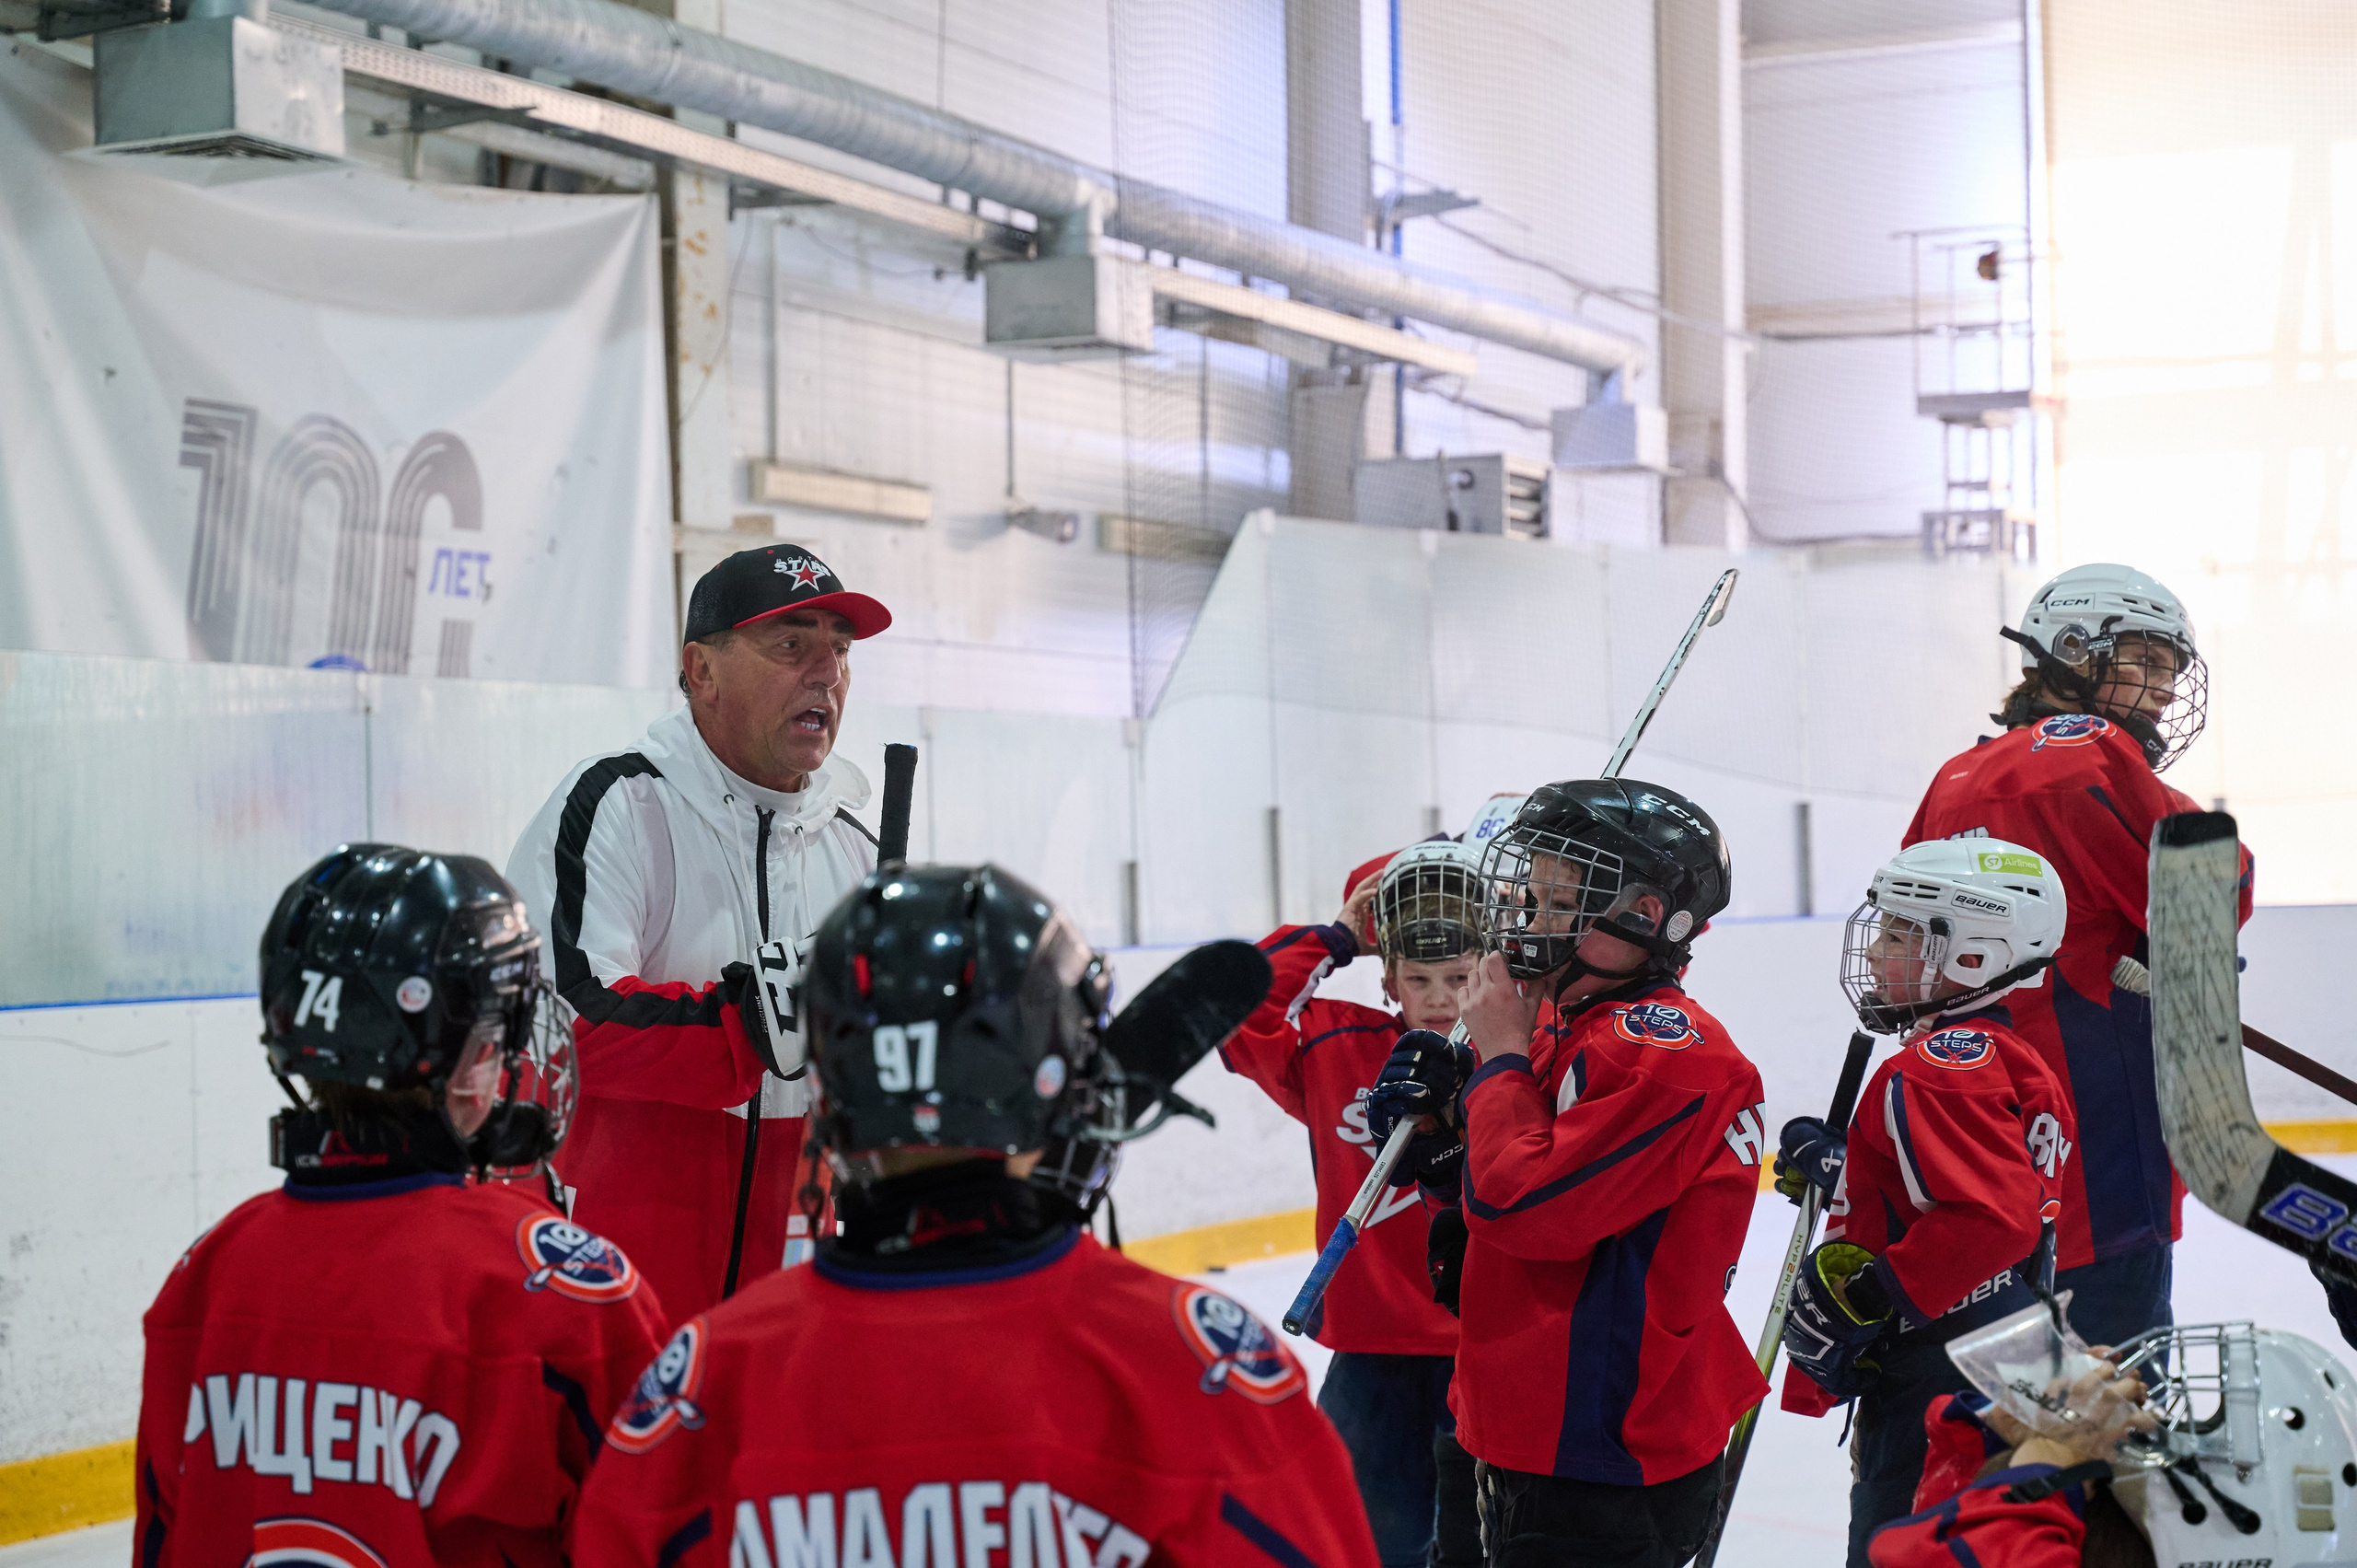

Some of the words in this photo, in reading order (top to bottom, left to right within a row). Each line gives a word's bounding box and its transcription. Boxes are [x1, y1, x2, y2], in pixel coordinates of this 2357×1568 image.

[2050, 598, 2090, 607] CCM
[1641, 793, 1712, 836] CCM
[1476, 818, 1505, 839] 86
[2004, 858, 2038, 869] Airlines
[1956, 895, 2007, 914] BAUER
[294, 970, 343, 1033] 74
[1946, 986, 1991, 1006] BAUER
[1645, 1005, 1680, 1020] 10
[1629, 1014, 1684, 1035] STEPS
[1930, 1039, 1982, 1052] STEPS
[874, 1018, 938, 1094] 97
[538, 1224, 589, 1254] 10
